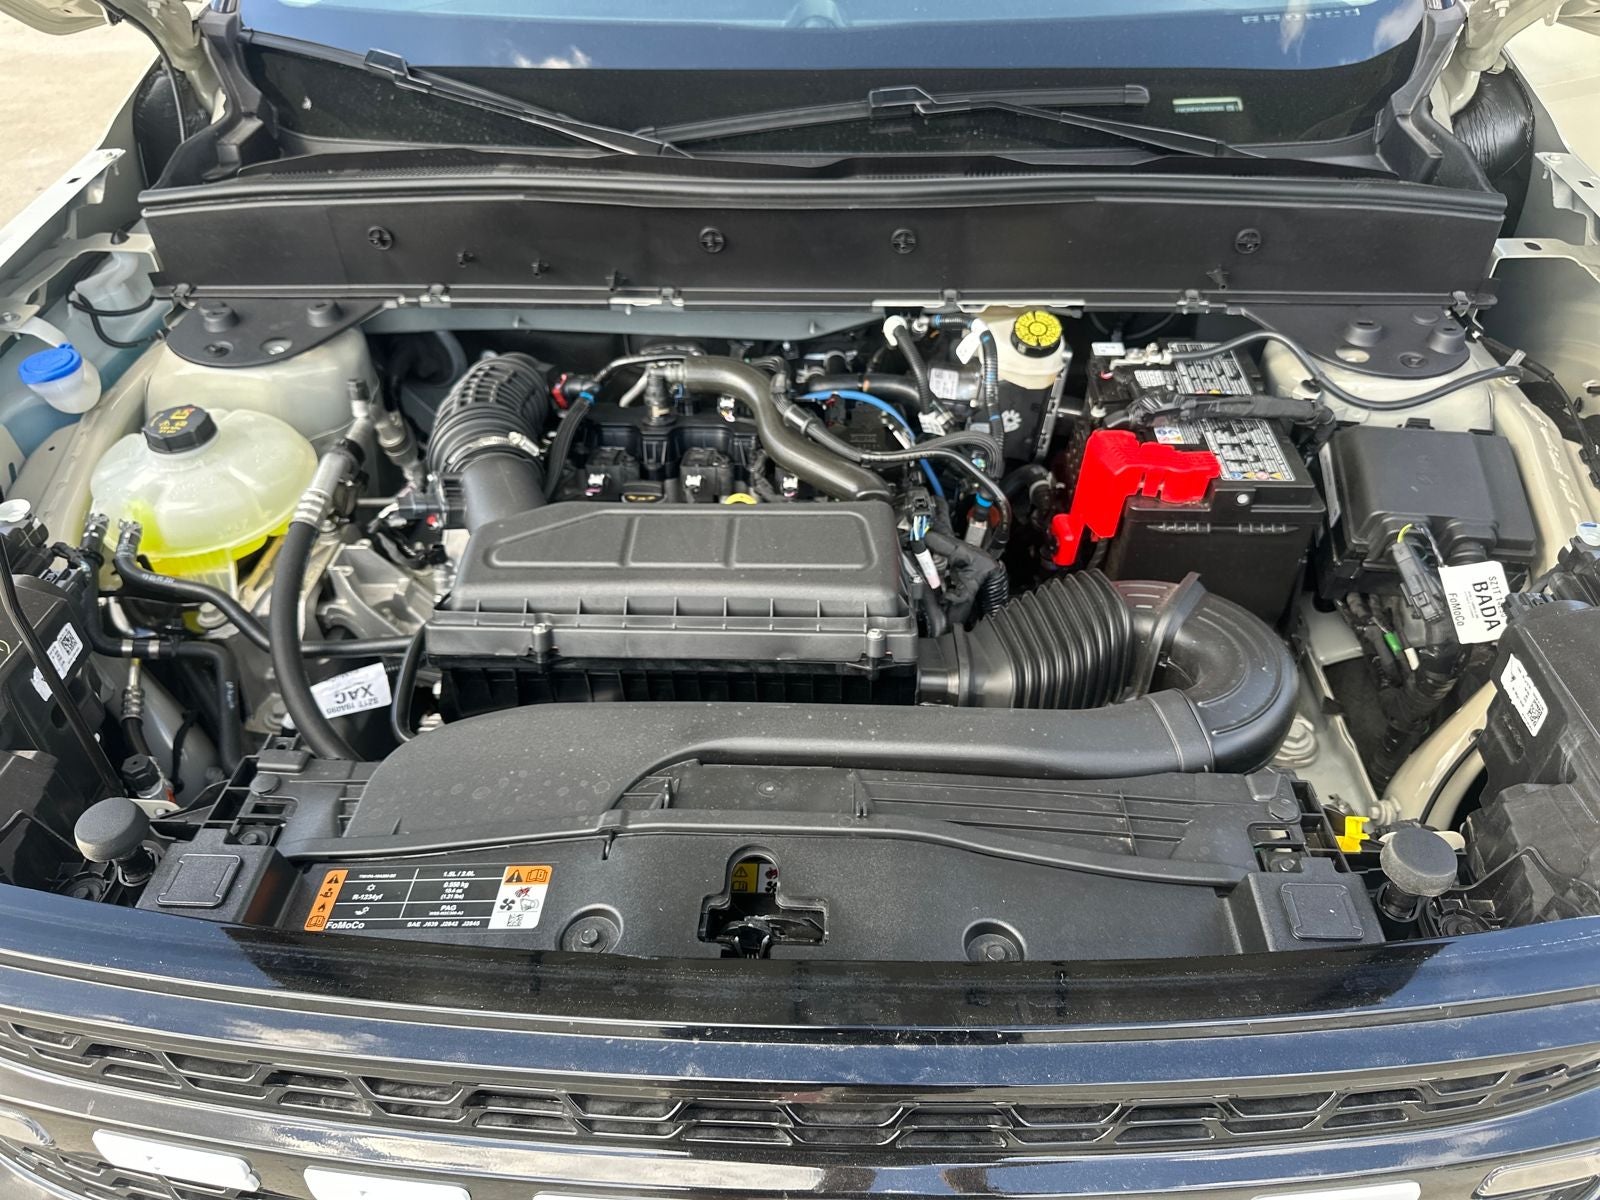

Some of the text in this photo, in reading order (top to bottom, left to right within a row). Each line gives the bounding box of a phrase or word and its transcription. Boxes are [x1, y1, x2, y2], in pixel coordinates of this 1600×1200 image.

[1448, 593, 1465, 627] FoMoCo
[1472, 581, 1501, 632] BADA
[334, 684, 374, 704] XAC
[325, 920, 366, 929] FoMoCo
